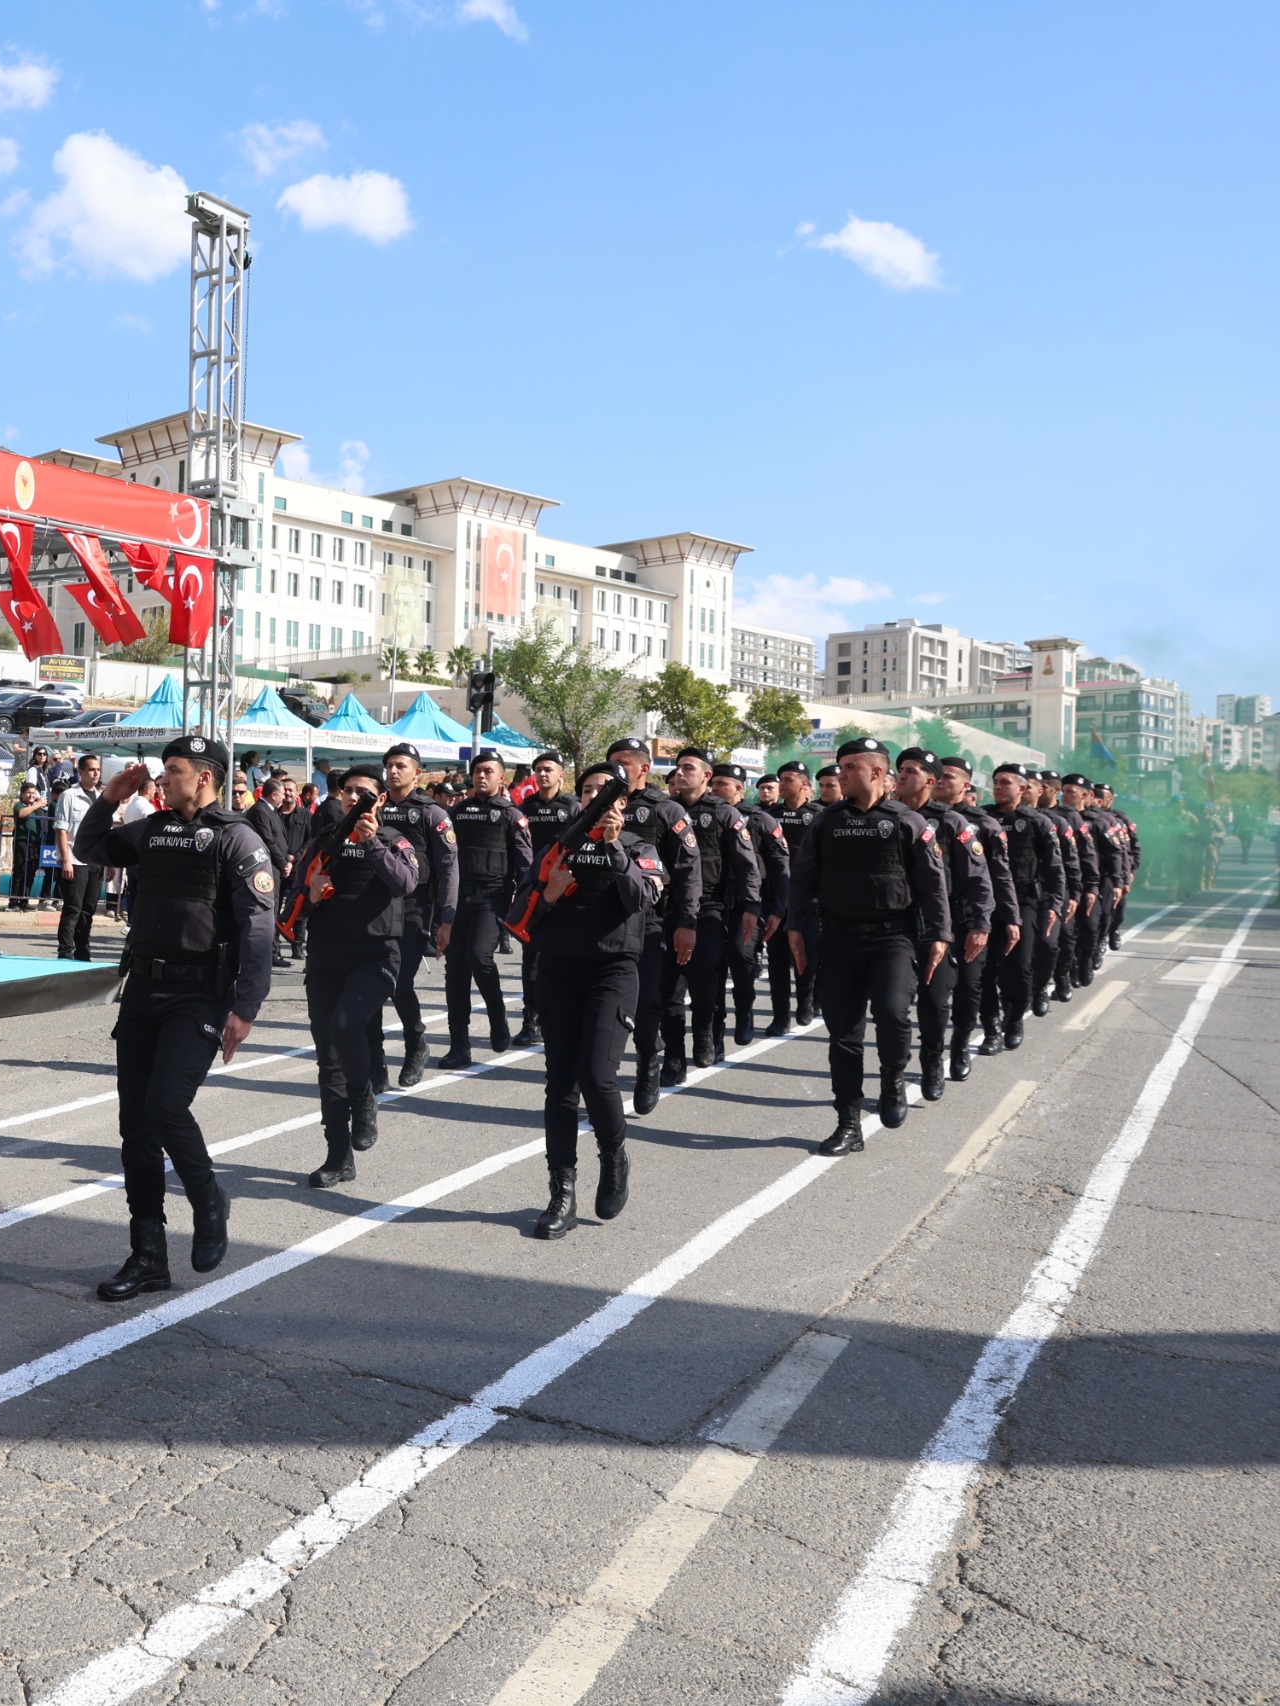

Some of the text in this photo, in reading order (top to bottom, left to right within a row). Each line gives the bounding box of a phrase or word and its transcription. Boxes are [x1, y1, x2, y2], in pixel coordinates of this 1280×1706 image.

[49, 658, 77, 666] AVUKAT
[851, 828, 878, 837] KUVVET
[165, 836, 195, 848] KUVVET
[577, 854, 607, 865] KUVVET
